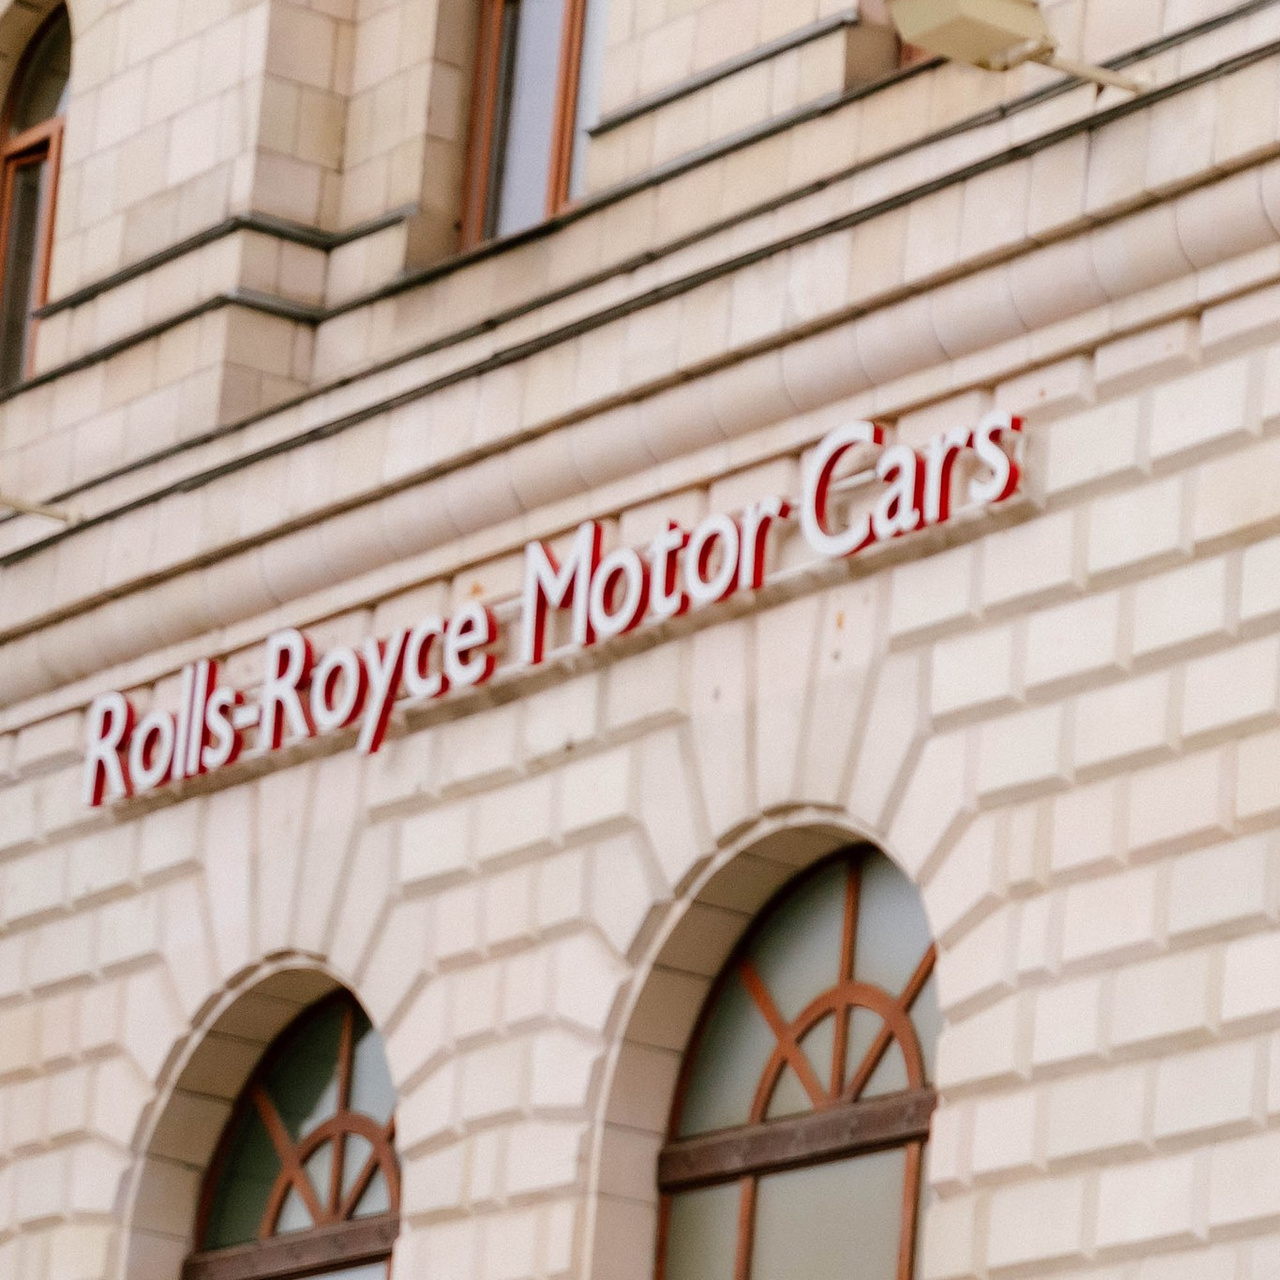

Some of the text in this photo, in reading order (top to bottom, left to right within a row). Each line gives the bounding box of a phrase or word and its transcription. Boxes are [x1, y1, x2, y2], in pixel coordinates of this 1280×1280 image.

[82, 411, 1024, 807] Rolls-Royce Motor Cars
